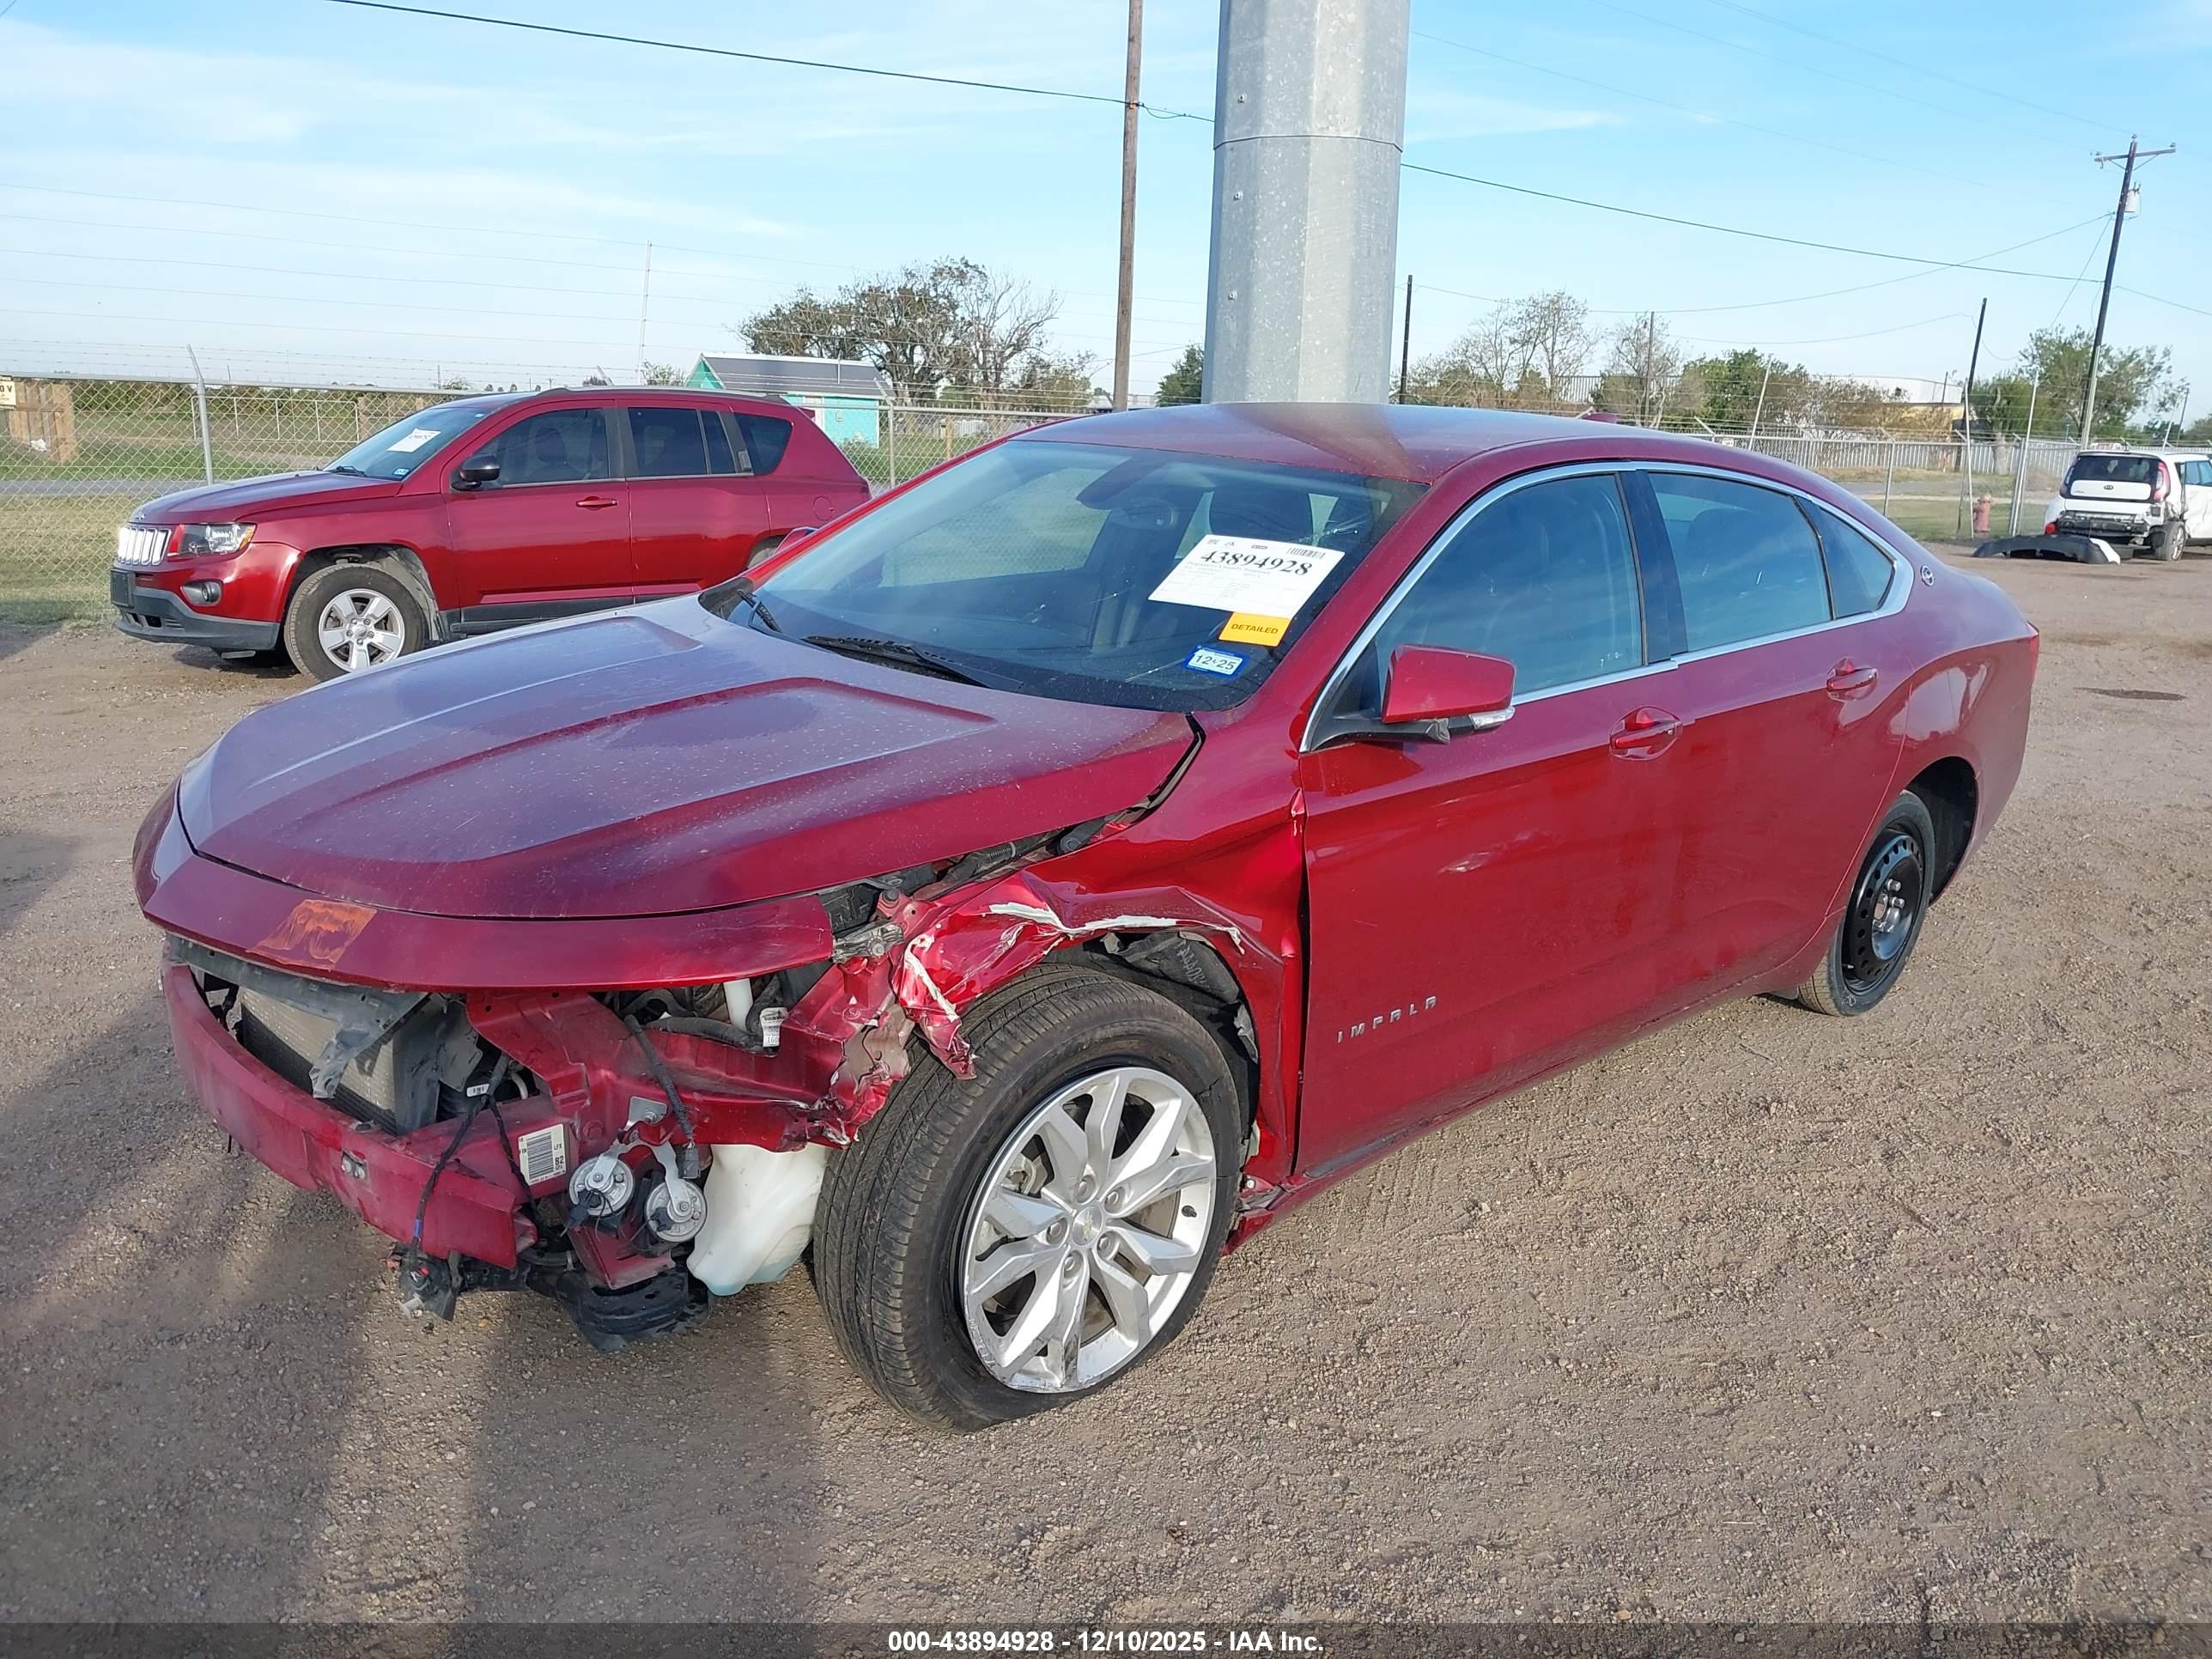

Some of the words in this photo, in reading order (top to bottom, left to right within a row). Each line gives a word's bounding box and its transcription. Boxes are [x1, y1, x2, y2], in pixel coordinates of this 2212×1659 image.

[1201, 550, 1313, 576] 43894928
[1231, 623, 1279, 635] DETAILED
[1337, 995, 1437, 1044] IMPALA
